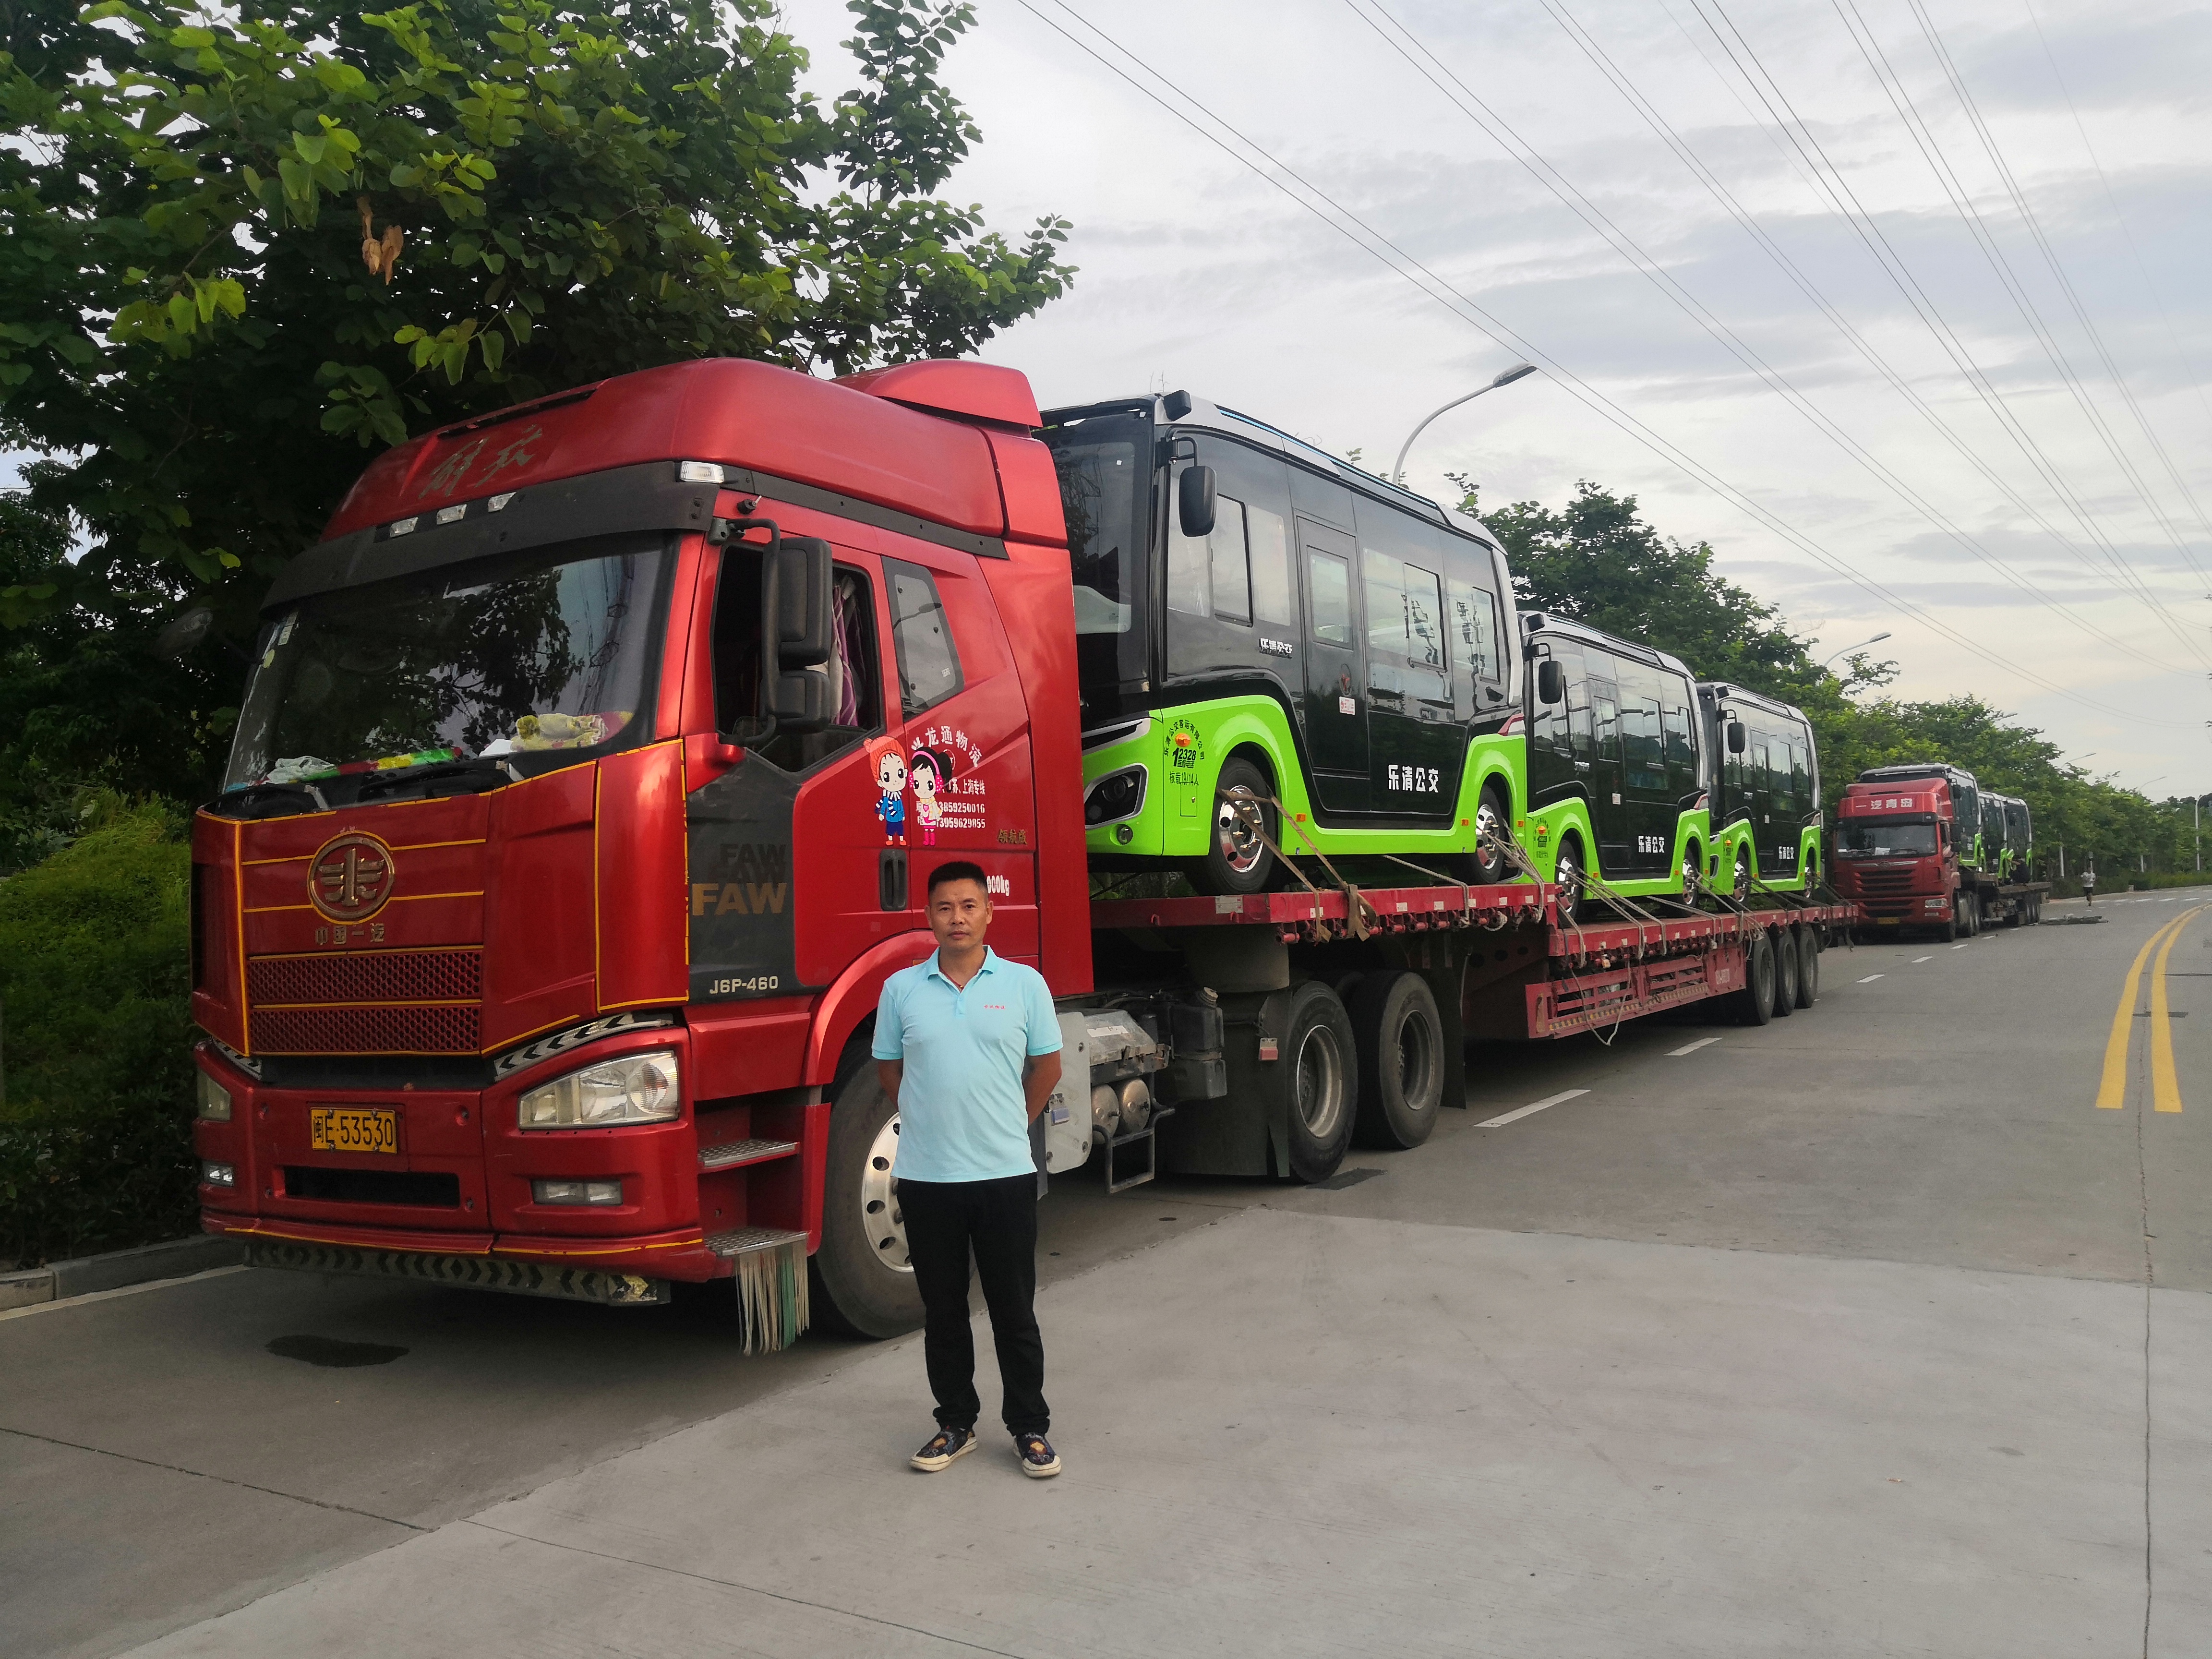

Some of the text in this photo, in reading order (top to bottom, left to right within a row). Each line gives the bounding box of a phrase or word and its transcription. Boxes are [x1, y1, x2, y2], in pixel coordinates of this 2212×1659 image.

[1172, 747, 1197, 767] 12328
[1388, 764, 1439, 793] 乐清公交
[938, 801, 985, 813] 3859250016
[1638, 835, 1665, 853] 乐清公交
[692, 883, 787, 916] FAW
[315, 923, 385, 946] 中国一汽
[709, 975, 779, 995] J6P-460
